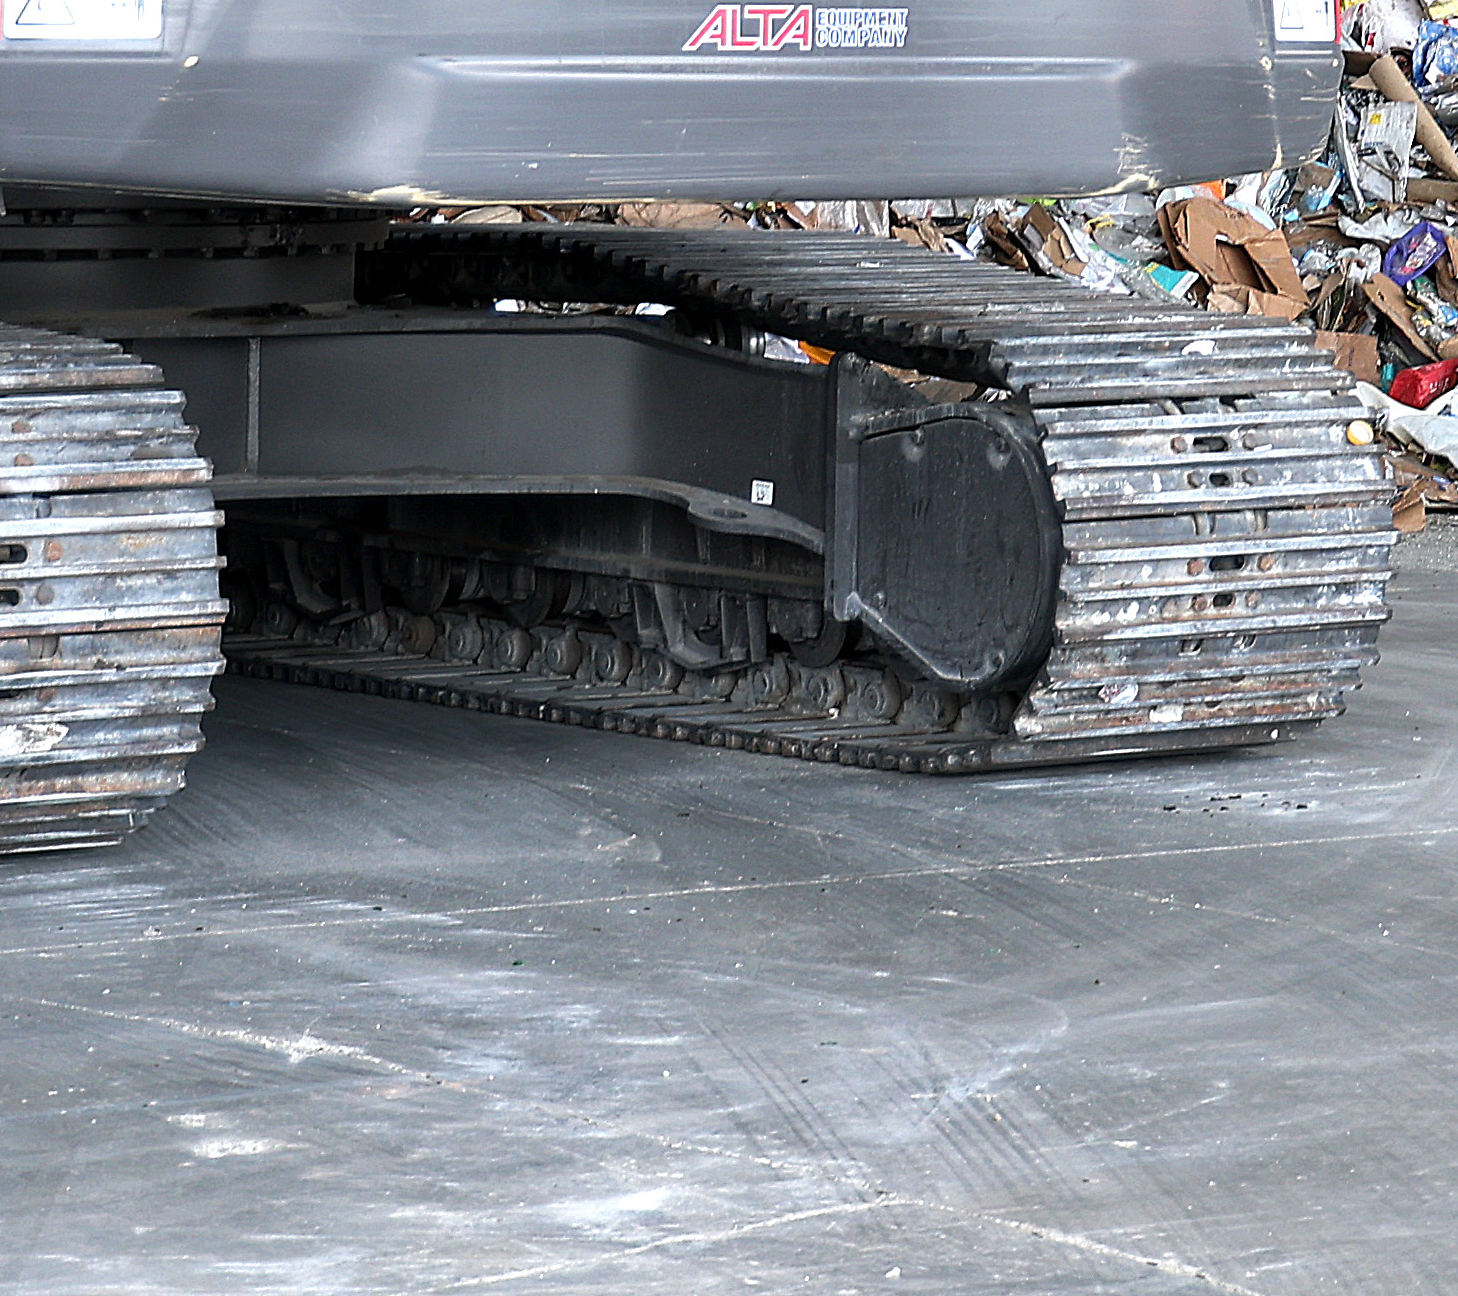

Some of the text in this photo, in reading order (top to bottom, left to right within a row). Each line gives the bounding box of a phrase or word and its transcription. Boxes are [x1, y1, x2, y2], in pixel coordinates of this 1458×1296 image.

[682, 4, 908, 51] ALTA EQUIPMENT
[816, 27, 908, 49] COMPANY
